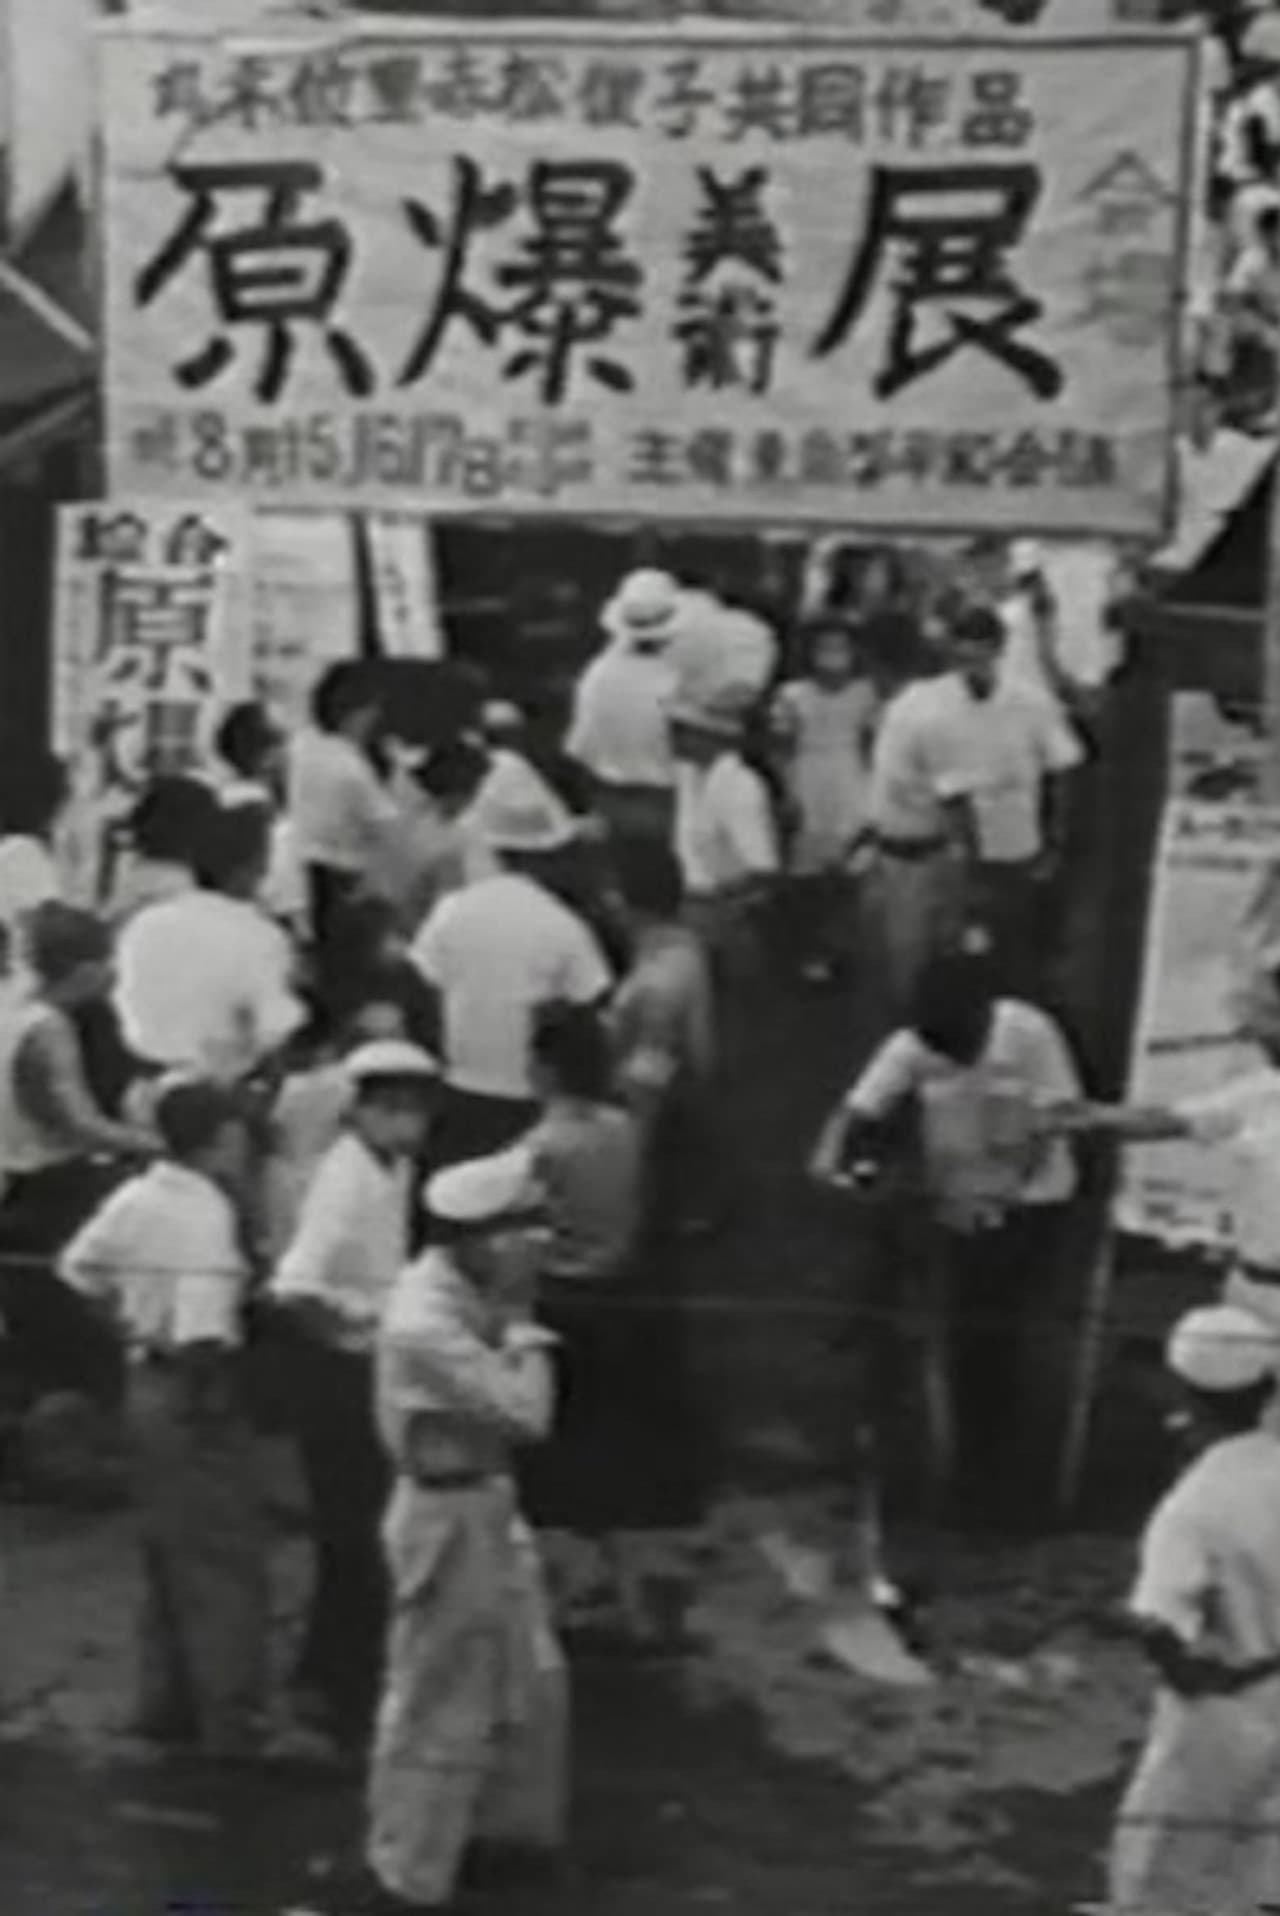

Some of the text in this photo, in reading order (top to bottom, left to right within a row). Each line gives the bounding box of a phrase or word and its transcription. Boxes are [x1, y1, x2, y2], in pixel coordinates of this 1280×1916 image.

[133, 154, 1067, 404] 原爆美術展
